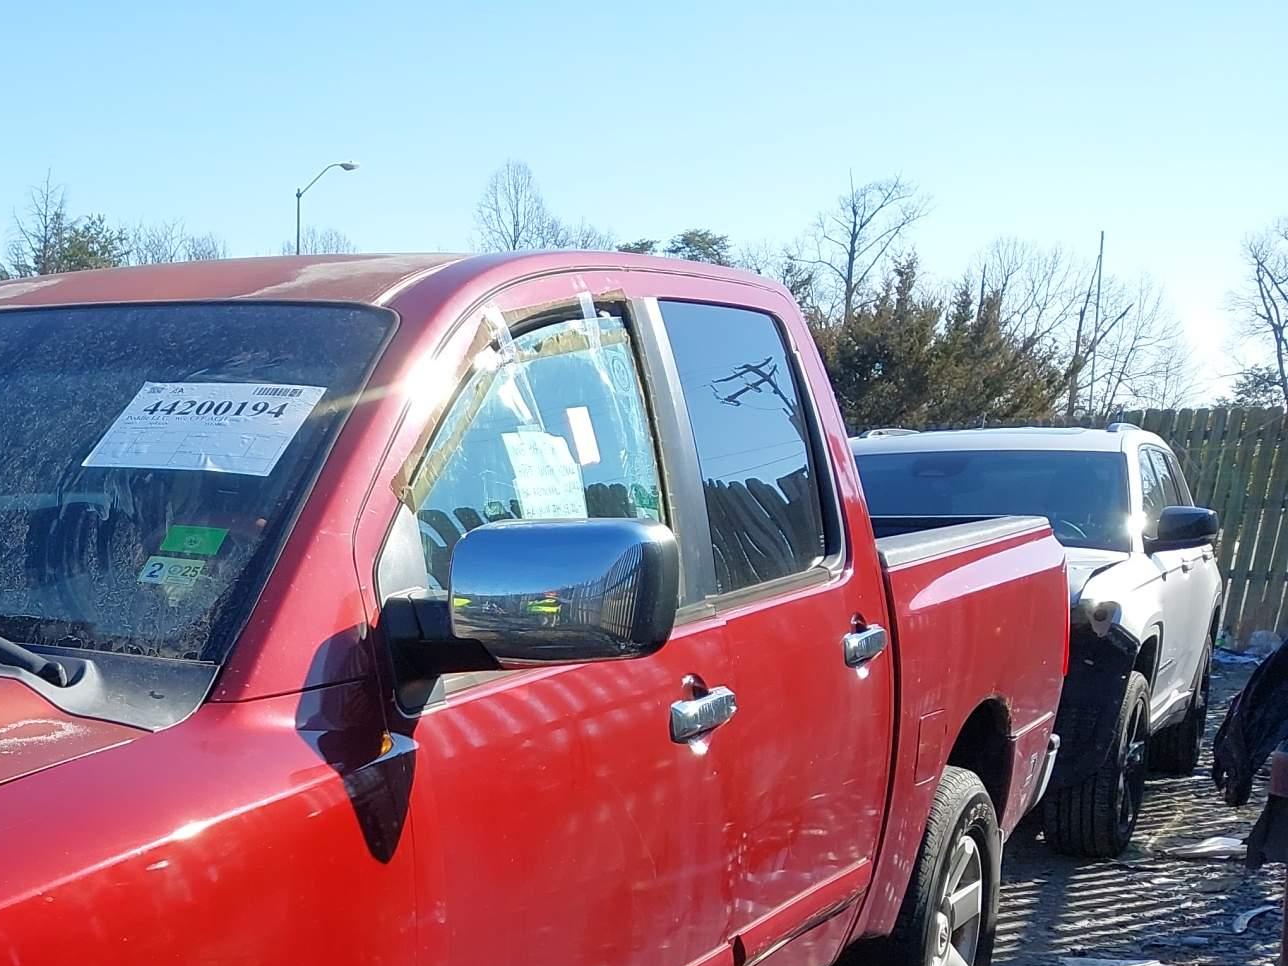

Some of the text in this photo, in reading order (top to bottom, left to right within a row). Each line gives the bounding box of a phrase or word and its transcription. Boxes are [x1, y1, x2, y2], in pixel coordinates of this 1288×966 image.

[143, 399, 289, 418] 44200194
[146, 562, 164, 578] 2
[181, 565, 201, 578] 25
